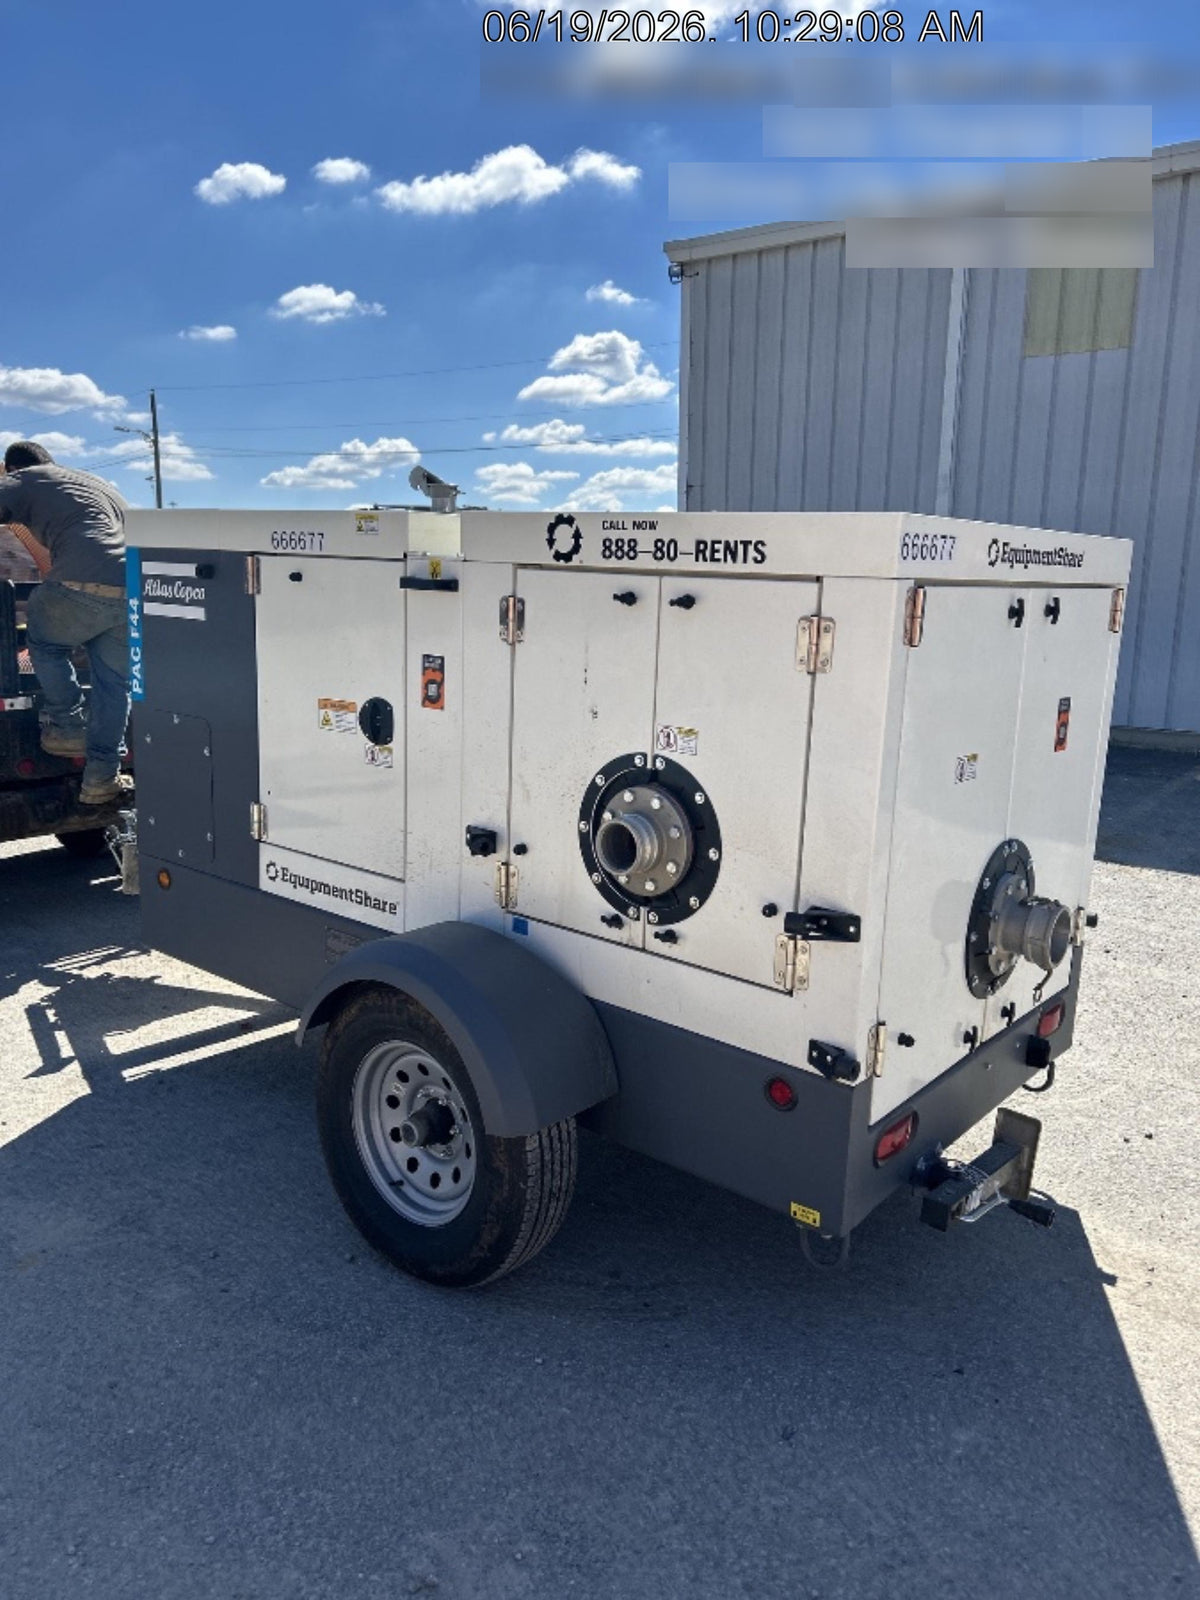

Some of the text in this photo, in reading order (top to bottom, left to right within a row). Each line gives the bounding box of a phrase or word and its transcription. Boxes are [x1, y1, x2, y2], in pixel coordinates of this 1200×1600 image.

[602, 520, 659, 531] CALL NOW
[271, 530, 325, 552] 666677
[900, 532, 956, 561] 666677
[1000, 541, 1084, 569] EquipmentShare
[143, 578, 205, 603] Atlas Copco
[128, 597, 144, 695] PAC F44
[281, 866, 398, 916] EquipmentShare
